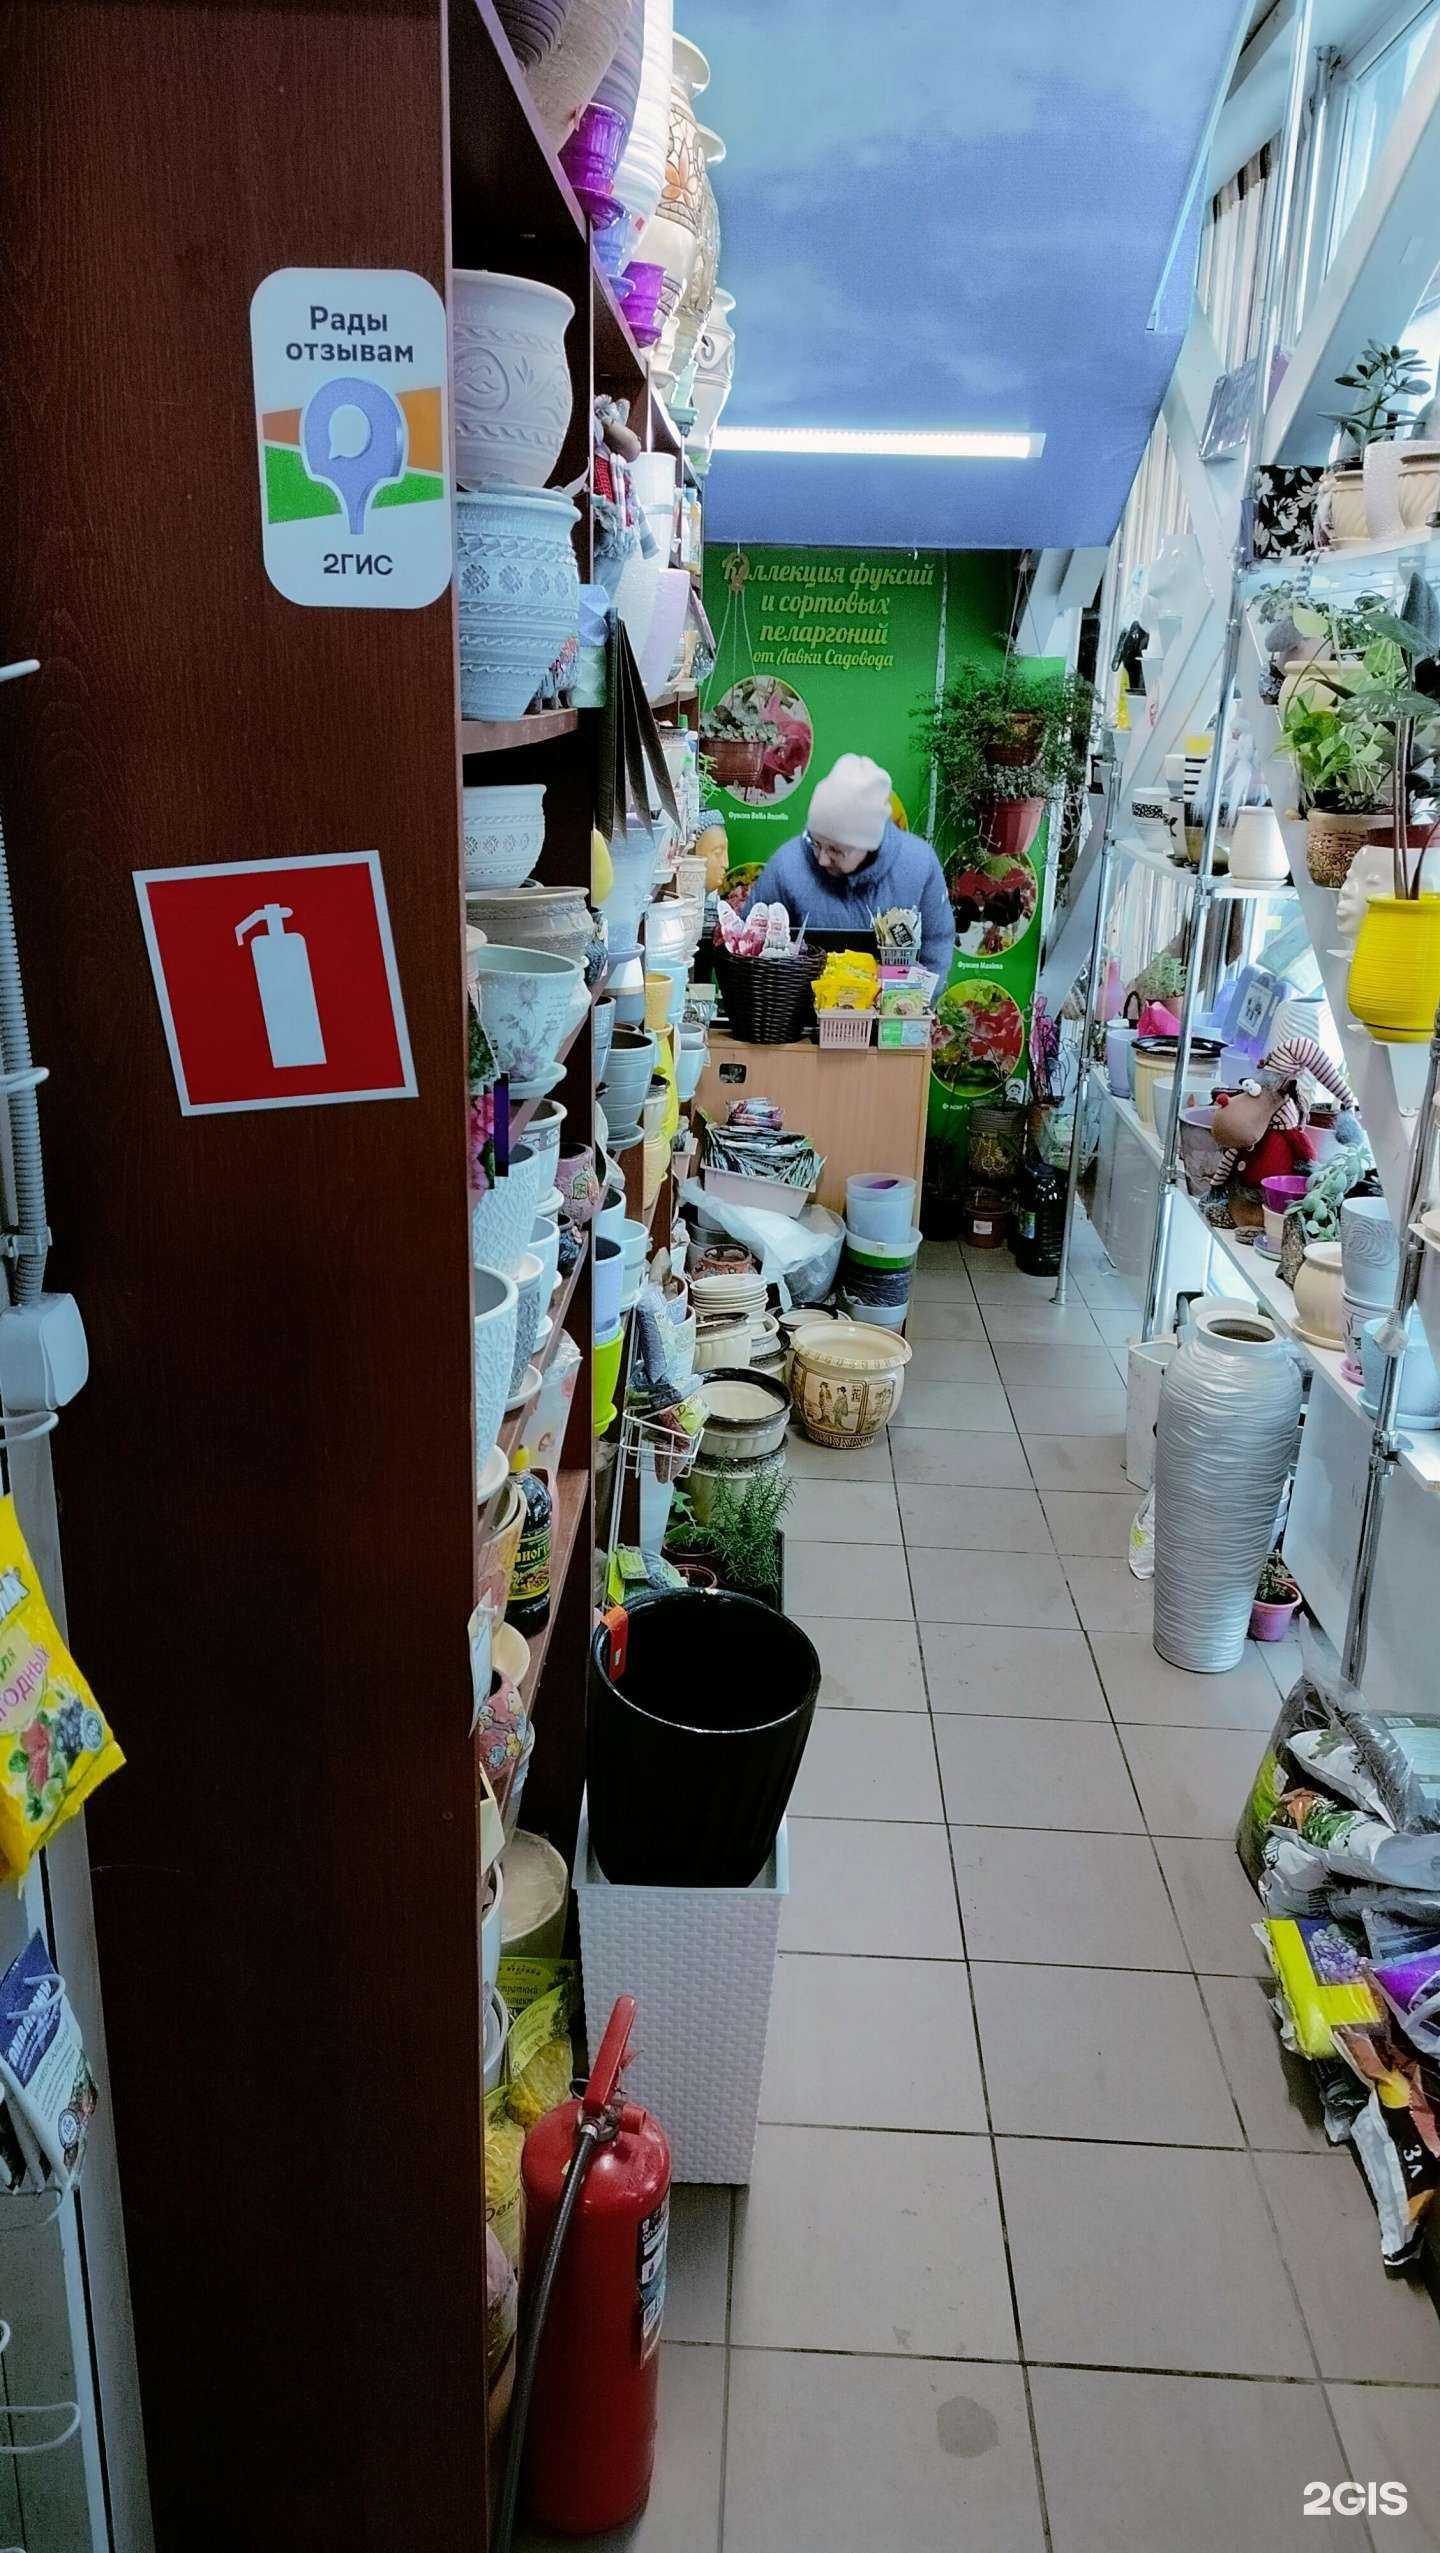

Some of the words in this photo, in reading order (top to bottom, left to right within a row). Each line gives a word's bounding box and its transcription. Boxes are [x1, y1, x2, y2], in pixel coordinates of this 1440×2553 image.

[310, 305, 388, 335] Рады
[286, 342, 413, 363] отзывам
[323, 553, 393, 575] 2ГИС
[849, 562, 935, 591] фуксий
[760, 592, 775, 612] и
[778, 590, 891, 619] сортовых
[759, 622, 889, 649] пеларгоний
[752, 652, 774, 664] от
[776, 647, 823, 666] Лавки
[824, 649, 894, 671] Садовода
